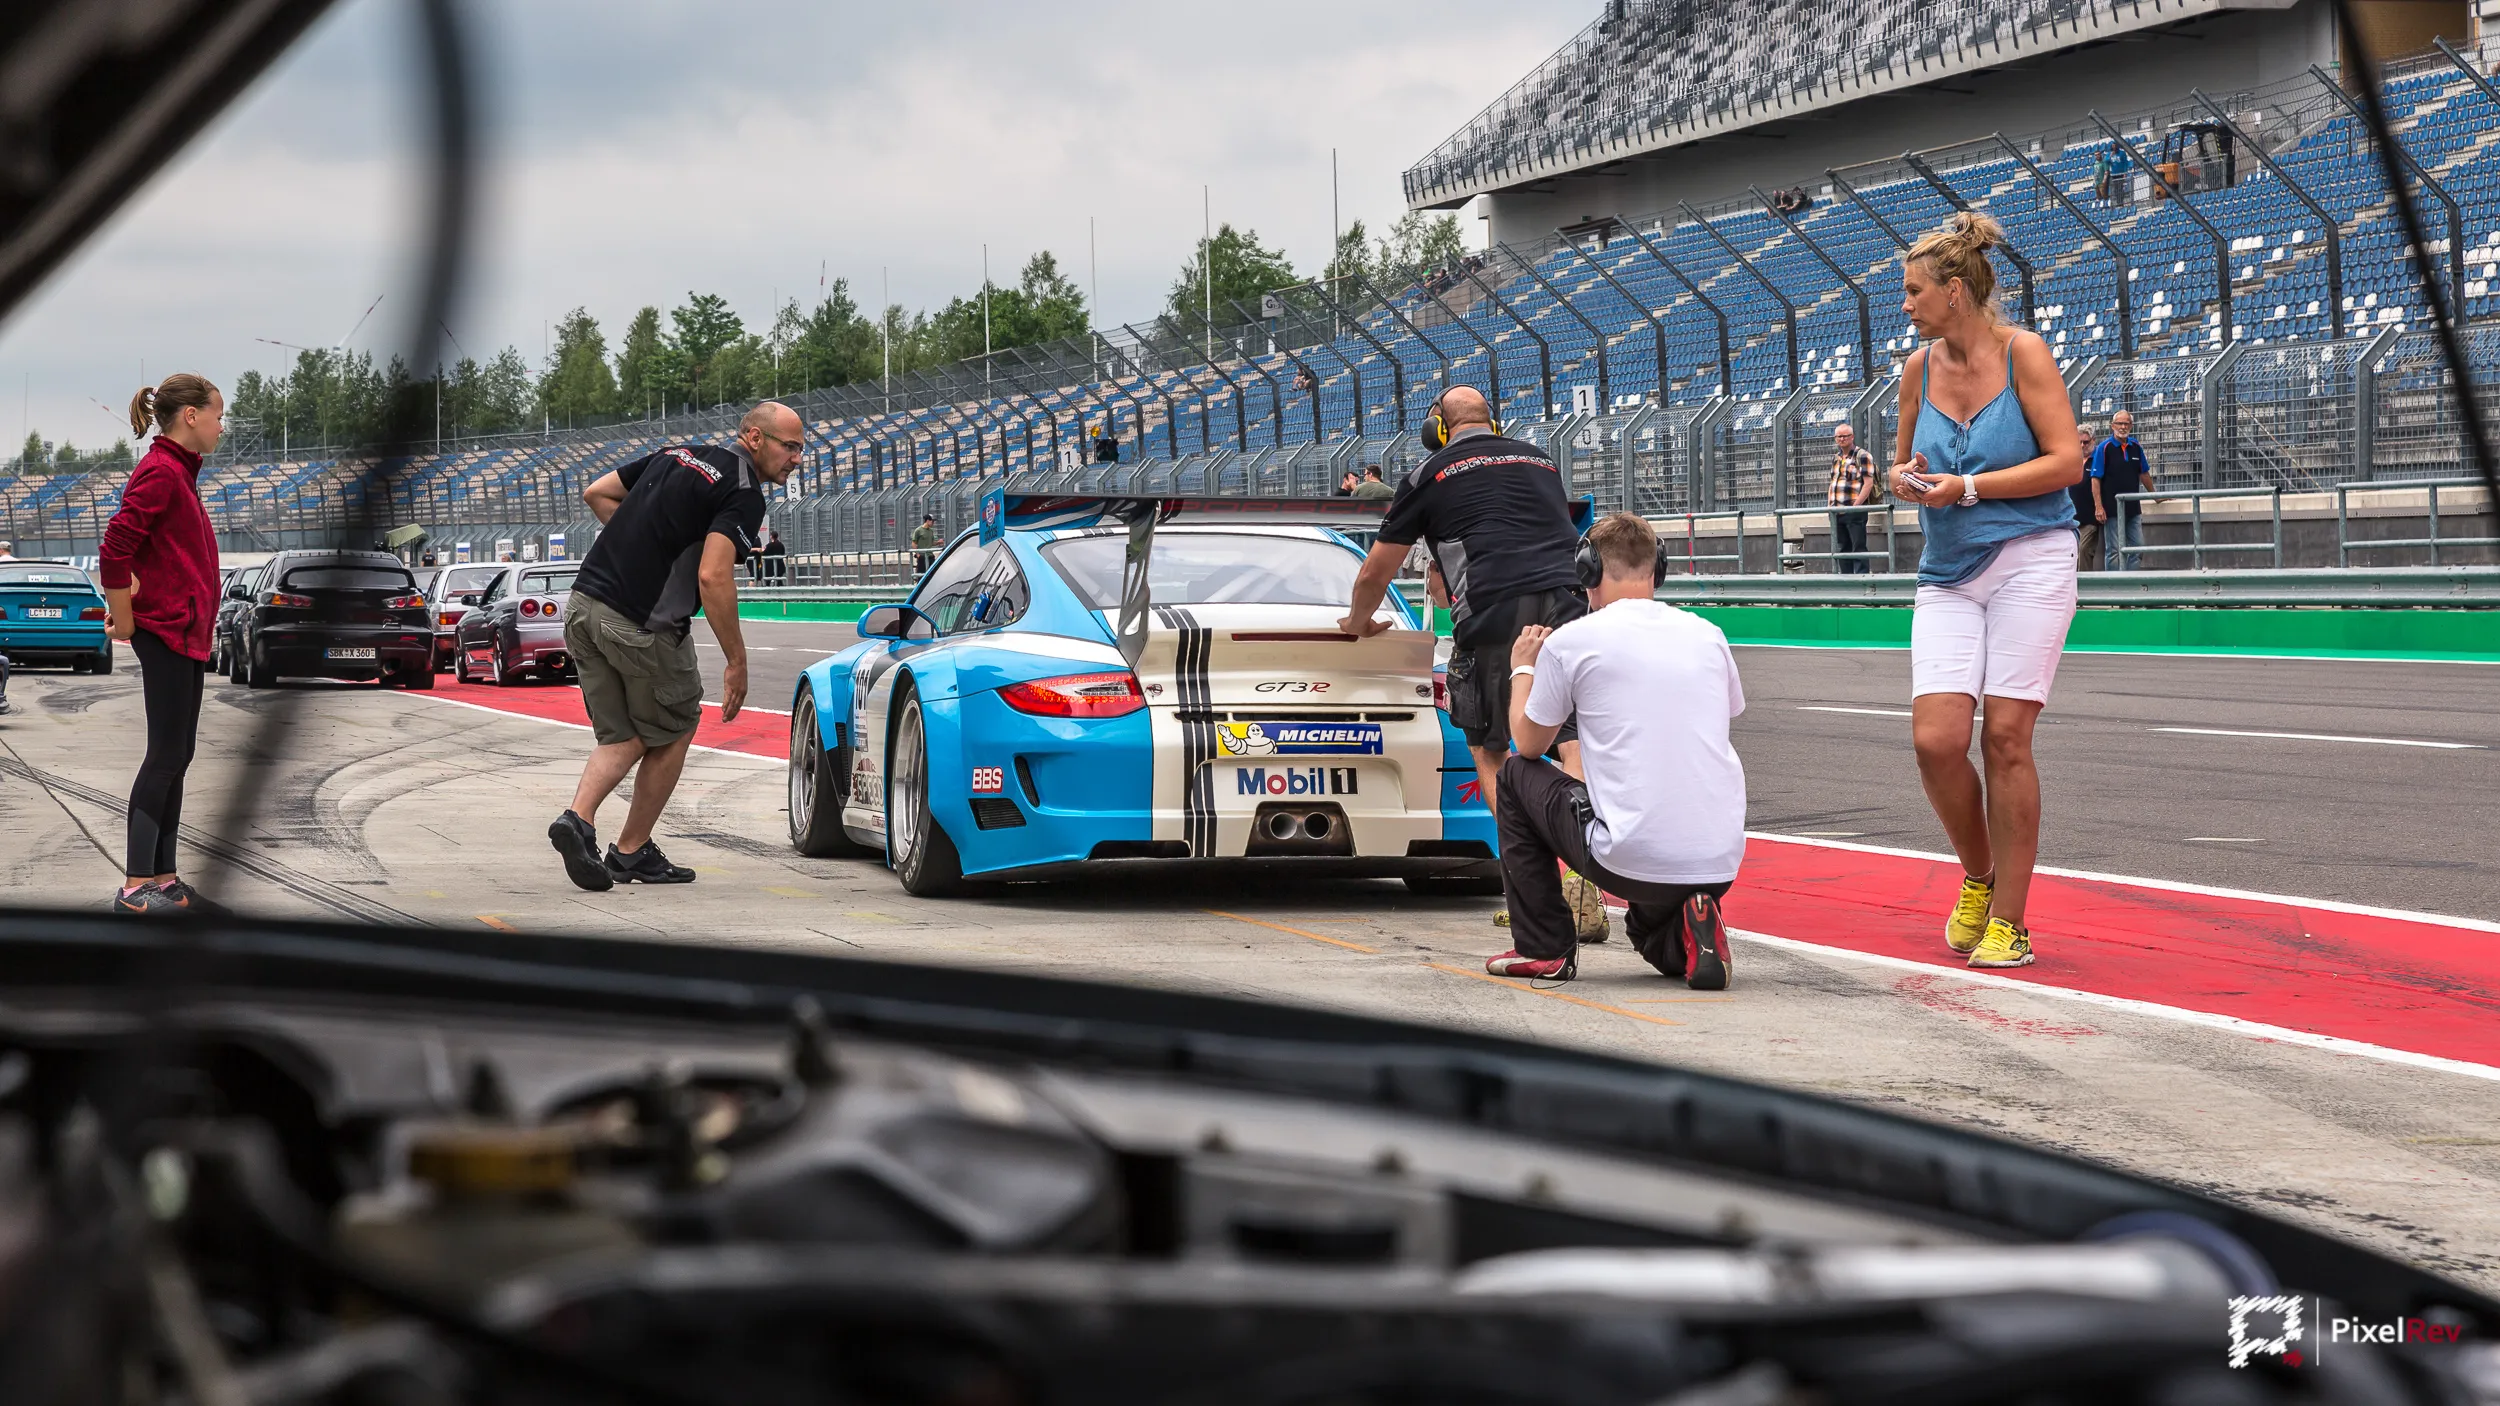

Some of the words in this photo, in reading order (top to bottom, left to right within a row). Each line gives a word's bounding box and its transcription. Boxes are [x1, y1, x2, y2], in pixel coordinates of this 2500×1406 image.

[1162, 500, 1391, 514] PORSCH
[329, 648, 344, 658] SBK
[349, 648, 355, 658] X
[356, 648, 370, 658] 360
[1278, 729, 1380, 742] MICHELIN
[972, 767, 1003, 792] BBS
[1237, 767, 1325, 795] Mobil
